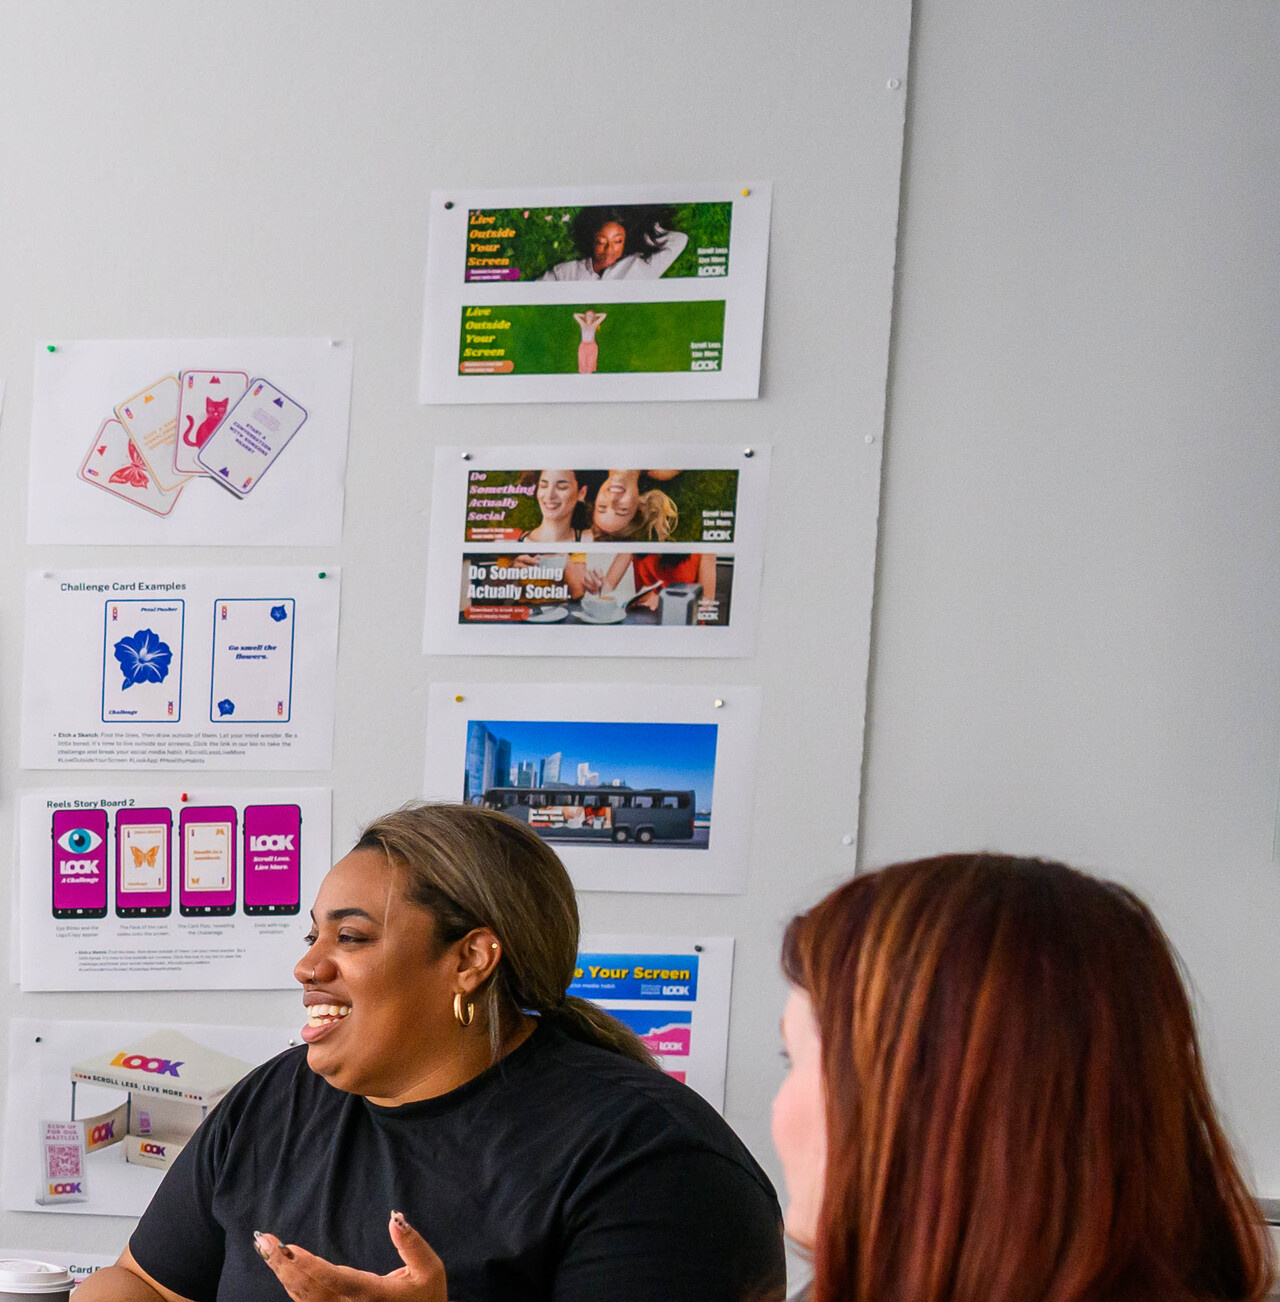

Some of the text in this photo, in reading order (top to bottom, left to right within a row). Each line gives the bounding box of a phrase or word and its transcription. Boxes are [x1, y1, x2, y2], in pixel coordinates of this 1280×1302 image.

[470, 215, 495, 224] Live
[469, 228, 516, 239] Outside
[470, 243, 500, 252] Your
[468, 257, 509, 266] Screen
[698, 266, 726, 276] LOOK
[466, 308, 491, 316] Live
[465, 320, 511, 329] Outside
[466, 334, 496, 343] Your
[464, 348, 505, 357] Screen
[691, 360, 718, 370] LOOK
[470, 472, 486, 480] Do
[470, 484, 536, 496] Something
[469, 498, 518, 509] Actually
[468, 511, 506, 520] Social
[703, 530, 731, 540] LOOK
[468, 566, 564, 582] Do Something
[60, 582, 186, 592] Challenge Card Examples
[467, 584, 571, 600] Actually Social.
[47, 801, 71, 809] Reels
[74, 800, 99, 809] Story
[101, 799, 127, 807] Board
[250, 834, 295, 852] LOOK
[60, 860, 99, 875] LOOK
[67, 876, 99, 884] Challenge
[589, 966, 690, 980] Your Screen
[662, 986, 689, 995] LOOK
[659, 1042, 682, 1051] LOOK
[109, 1052, 185, 1077] LOOK
[92, 1075, 183, 1097] SCROLL LIVE MORE
[88, 1119, 116, 1147] LOOK
[141, 1143, 166, 1157] LOOK
[49, 1182, 82, 1195] LOOK
[69, 1265, 92, 1274] Card
